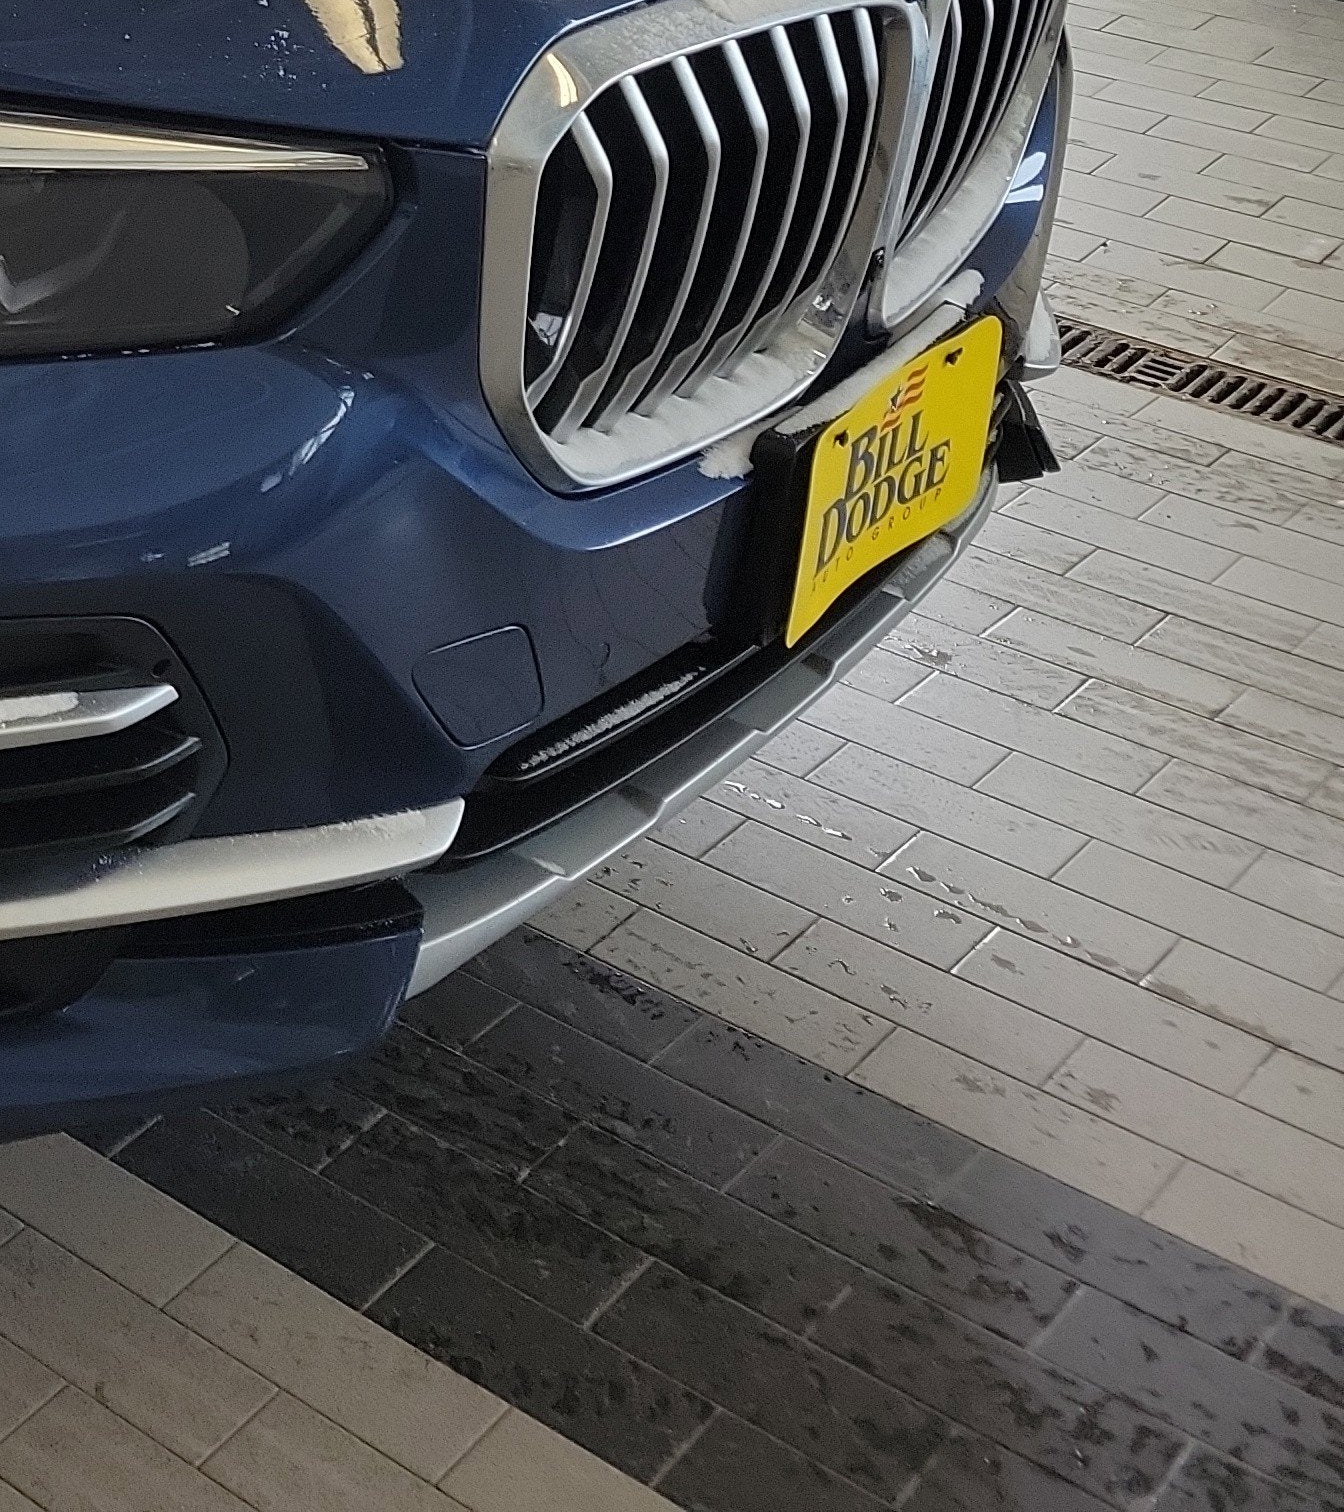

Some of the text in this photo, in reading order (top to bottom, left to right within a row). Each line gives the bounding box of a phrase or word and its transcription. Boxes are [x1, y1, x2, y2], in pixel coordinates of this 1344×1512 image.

[844, 409, 930, 502] BILL
[813, 438, 951, 578] DODGE
[871, 487, 942, 541] GROUP
